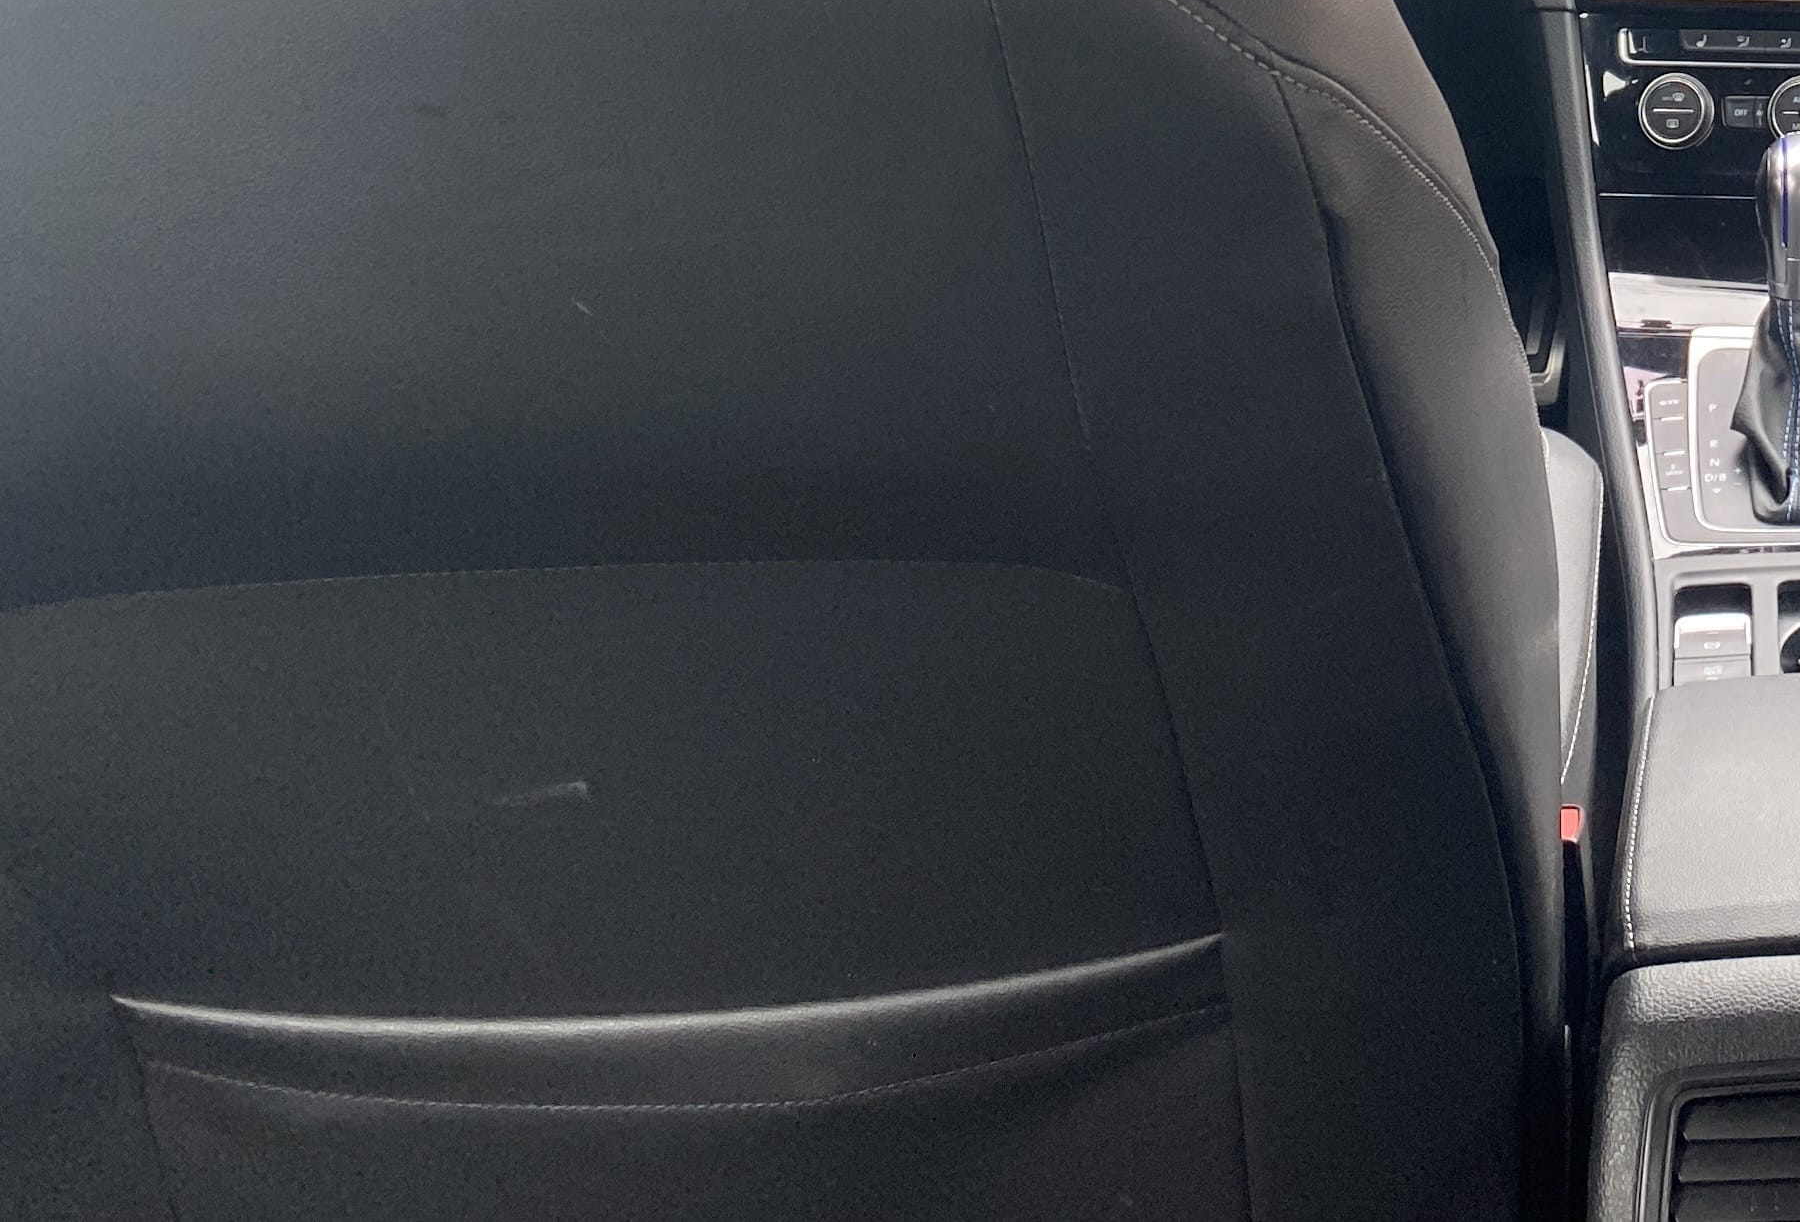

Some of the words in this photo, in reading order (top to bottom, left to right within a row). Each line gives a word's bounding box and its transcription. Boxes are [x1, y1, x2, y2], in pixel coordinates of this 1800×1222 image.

[1734, 108, 1748, 118] OFF
[1708, 404, 1717, 413] P
[1710, 440, 1718, 448] R
[1710, 458, 1720, 467] N
